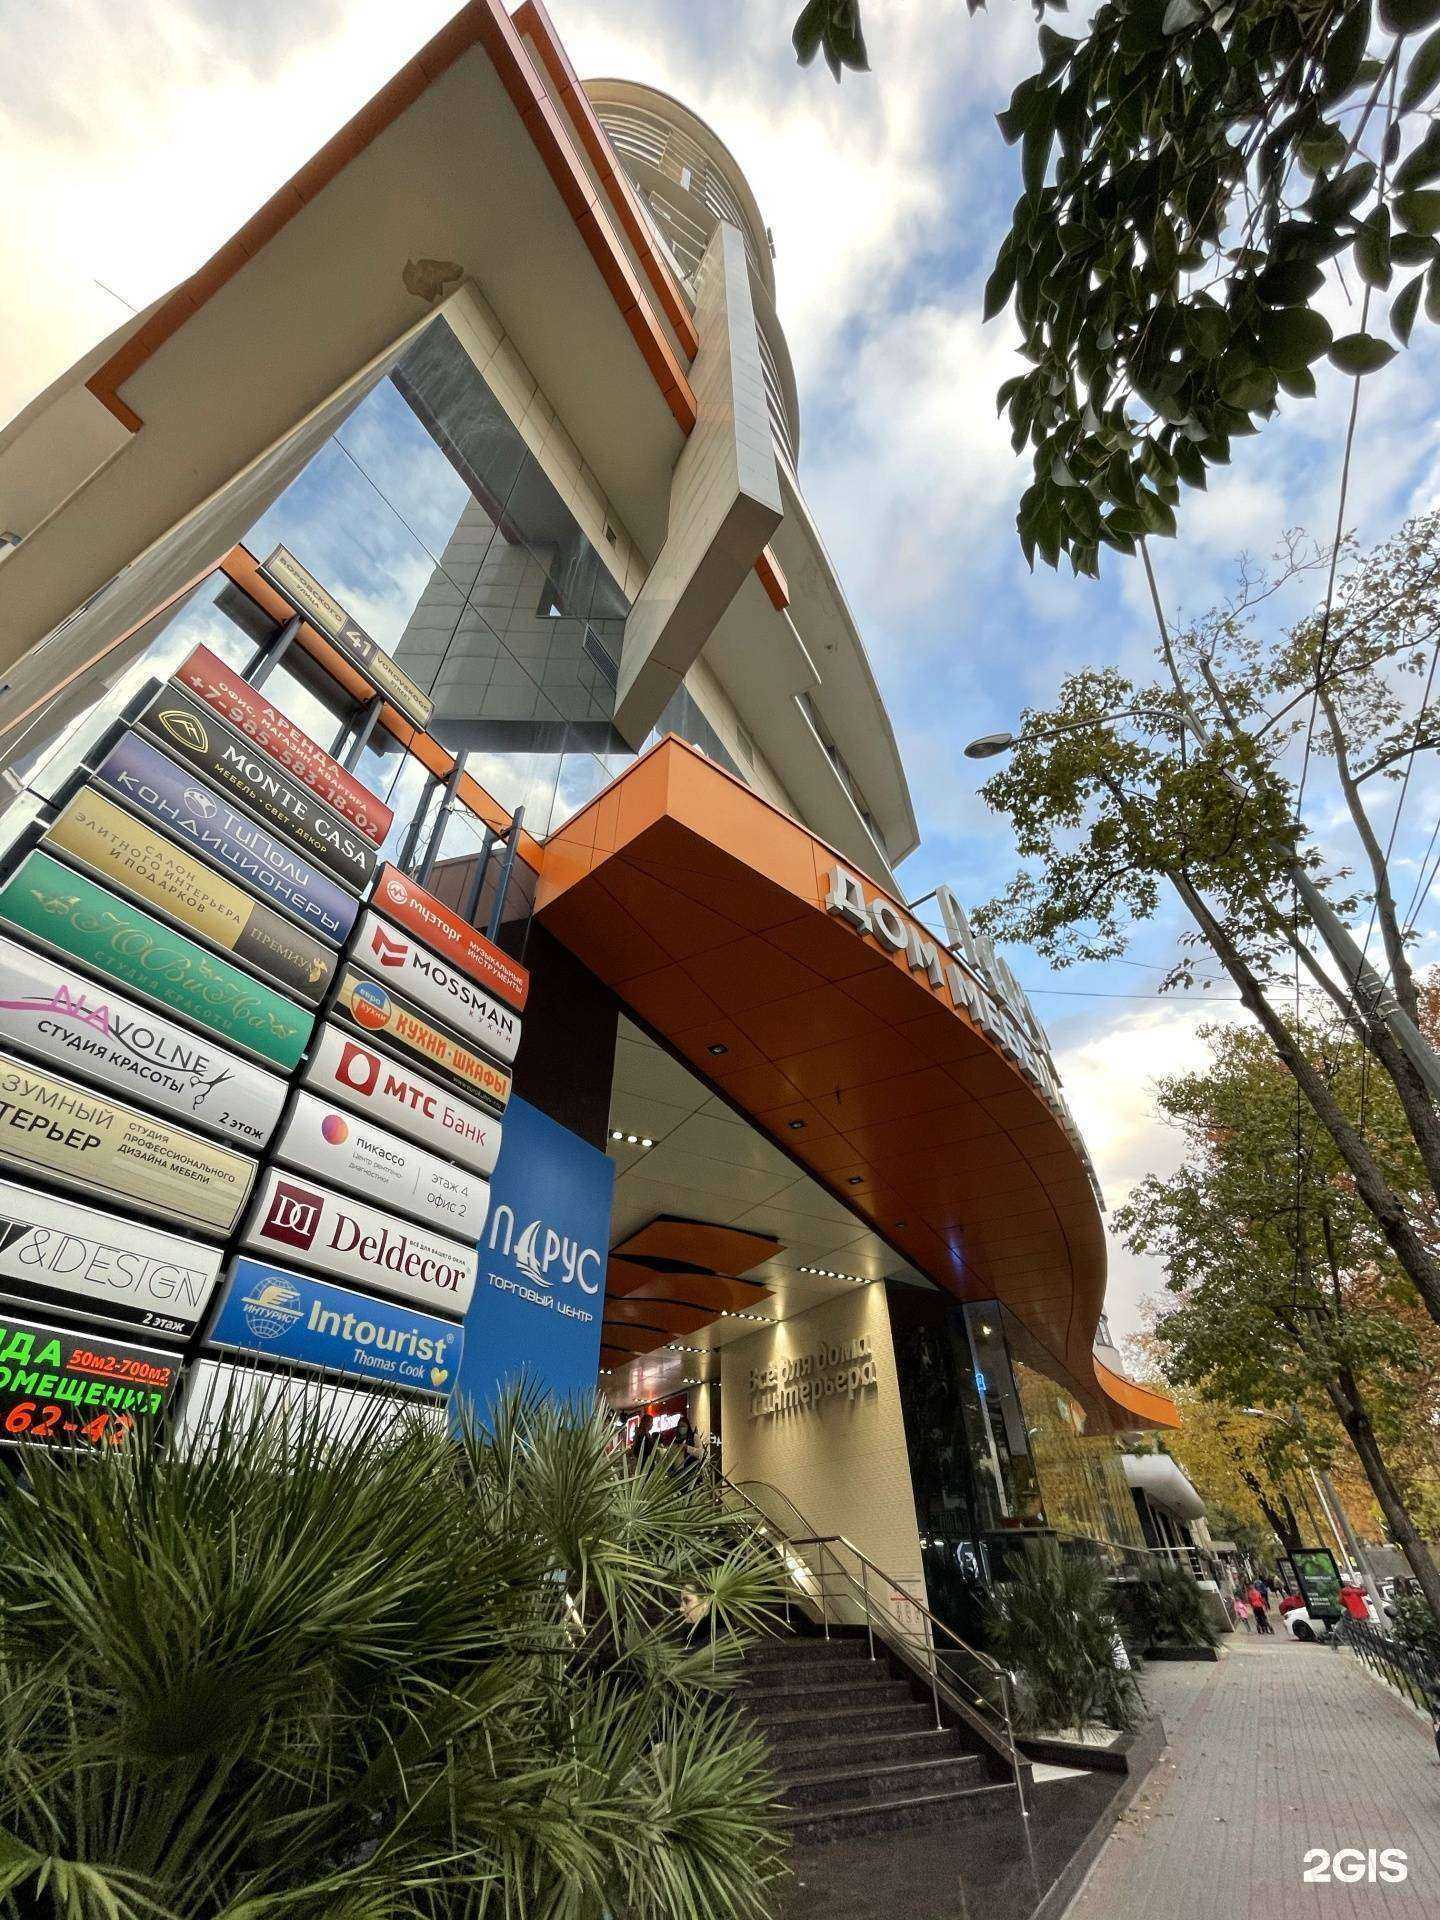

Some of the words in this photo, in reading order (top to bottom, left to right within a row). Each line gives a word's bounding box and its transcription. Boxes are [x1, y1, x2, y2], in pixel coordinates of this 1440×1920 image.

[345, 630, 373, 657] 41
[262, 707, 340, 778] АРЕНДА
[213, 763, 257, 799] МЕБЕЛЬ
[264, 802, 291, 824] СВЕТ
[295, 826, 328, 853] ДЕКОР
[221, 745, 309, 821] MONTE
[314, 818, 367, 871] CASA
[318, 766, 369, 812] КВАРТИРА
[75, 811, 161, 870] ЭЛИТНОГО
[164, 868, 241, 925] ИНТЕРЬЕРА
[117, 770, 340, 932] КОНДИЦИОНЕРЫ
[145, 844, 197, 882] САЛОН
[109, 847, 120, 859] И
[124, 857, 206, 914] ПОДАРКОВ
[824, 863, 945, 990] ДОМ
[467, 948, 523, 994] ИНСТРУМЕНТЫ
[469, 940, 523, 986] МУЗЫКАЛЬНЫЕ
[412, 951, 513, 1035] MOSSMAN
[37, 1019, 108, 1060] СТУДИЯ
[109, 1051, 185, 1094] КРАСОТЫ
[395, 1013, 447, 1060] КУХНИ
[452, 1050, 507, 1097] ШКАФЫ
[0, 1100, 102, 1152] ТЕРЬЕР
[2, 1074, 115, 1131] ЗУМНЫЙ
[218, 1112, 229, 1124] 2
[231, 1117, 264, 1141] этаж
[383, 1073, 437, 1120] МТС
[441, 1105, 487, 1147] Банк
[123, 1132, 236, 1183] ПРОФЕССИОНАЛЬНОГО
[128, 1121, 170, 1144] СТУДИЯ
[356, 1137, 405, 1167] пикассо
[117, 1143, 168, 1170] ДИЗАЙНА
[170, 1162, 211, 1186] МЕБЕЛИ
[431, 1173, 460, 1193] этаж
[460, 1186, 469, 1197] 4
[426, 1191, 457, 1213] офис
[457, 1204, 467, 1218] 2
[326, 1212, 466, 1293] Deldecor
[142, 1312, 152, 1325] 2
[152, 1315, 186, 1333] этаж
[243, 1303, 300, 1325] ИНТУРИСТ
[488, 1271, 555, 1310] ТОРГОВЫЙ
[557, 1304, 594, 1324] ЦЕНТР
[0, 1328, 61, 1367] ДА
[306, 1299, 448, 1365] Intourist
[353, 1348, 397, 1373] Thomas
[398, 1360, 426, 1380] Cook
